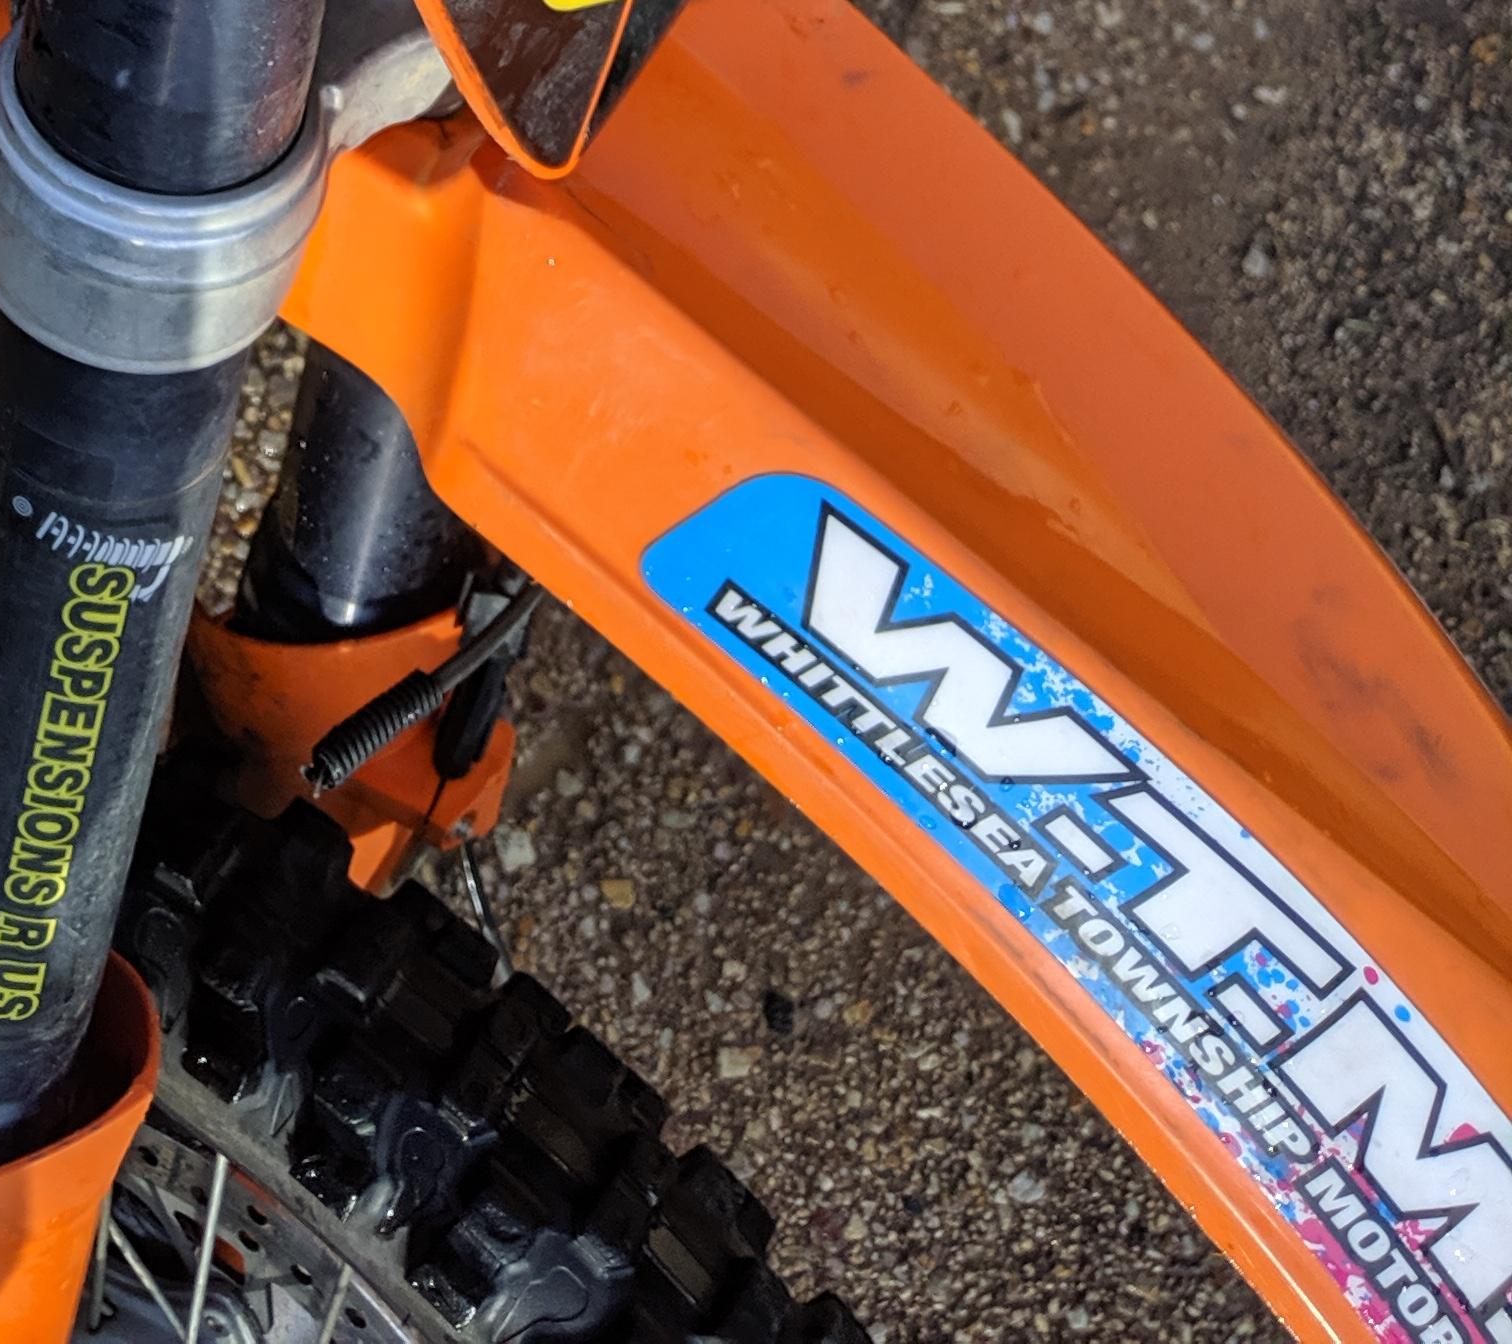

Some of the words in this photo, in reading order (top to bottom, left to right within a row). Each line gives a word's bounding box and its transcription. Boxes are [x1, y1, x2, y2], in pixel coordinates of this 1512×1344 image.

[3, 561, 136, 908] SUSPENSIONS
[710, 584, 1054, 894] WHITTLESEA
[1050, 883, 1315, 1157] TOWNSHIP
